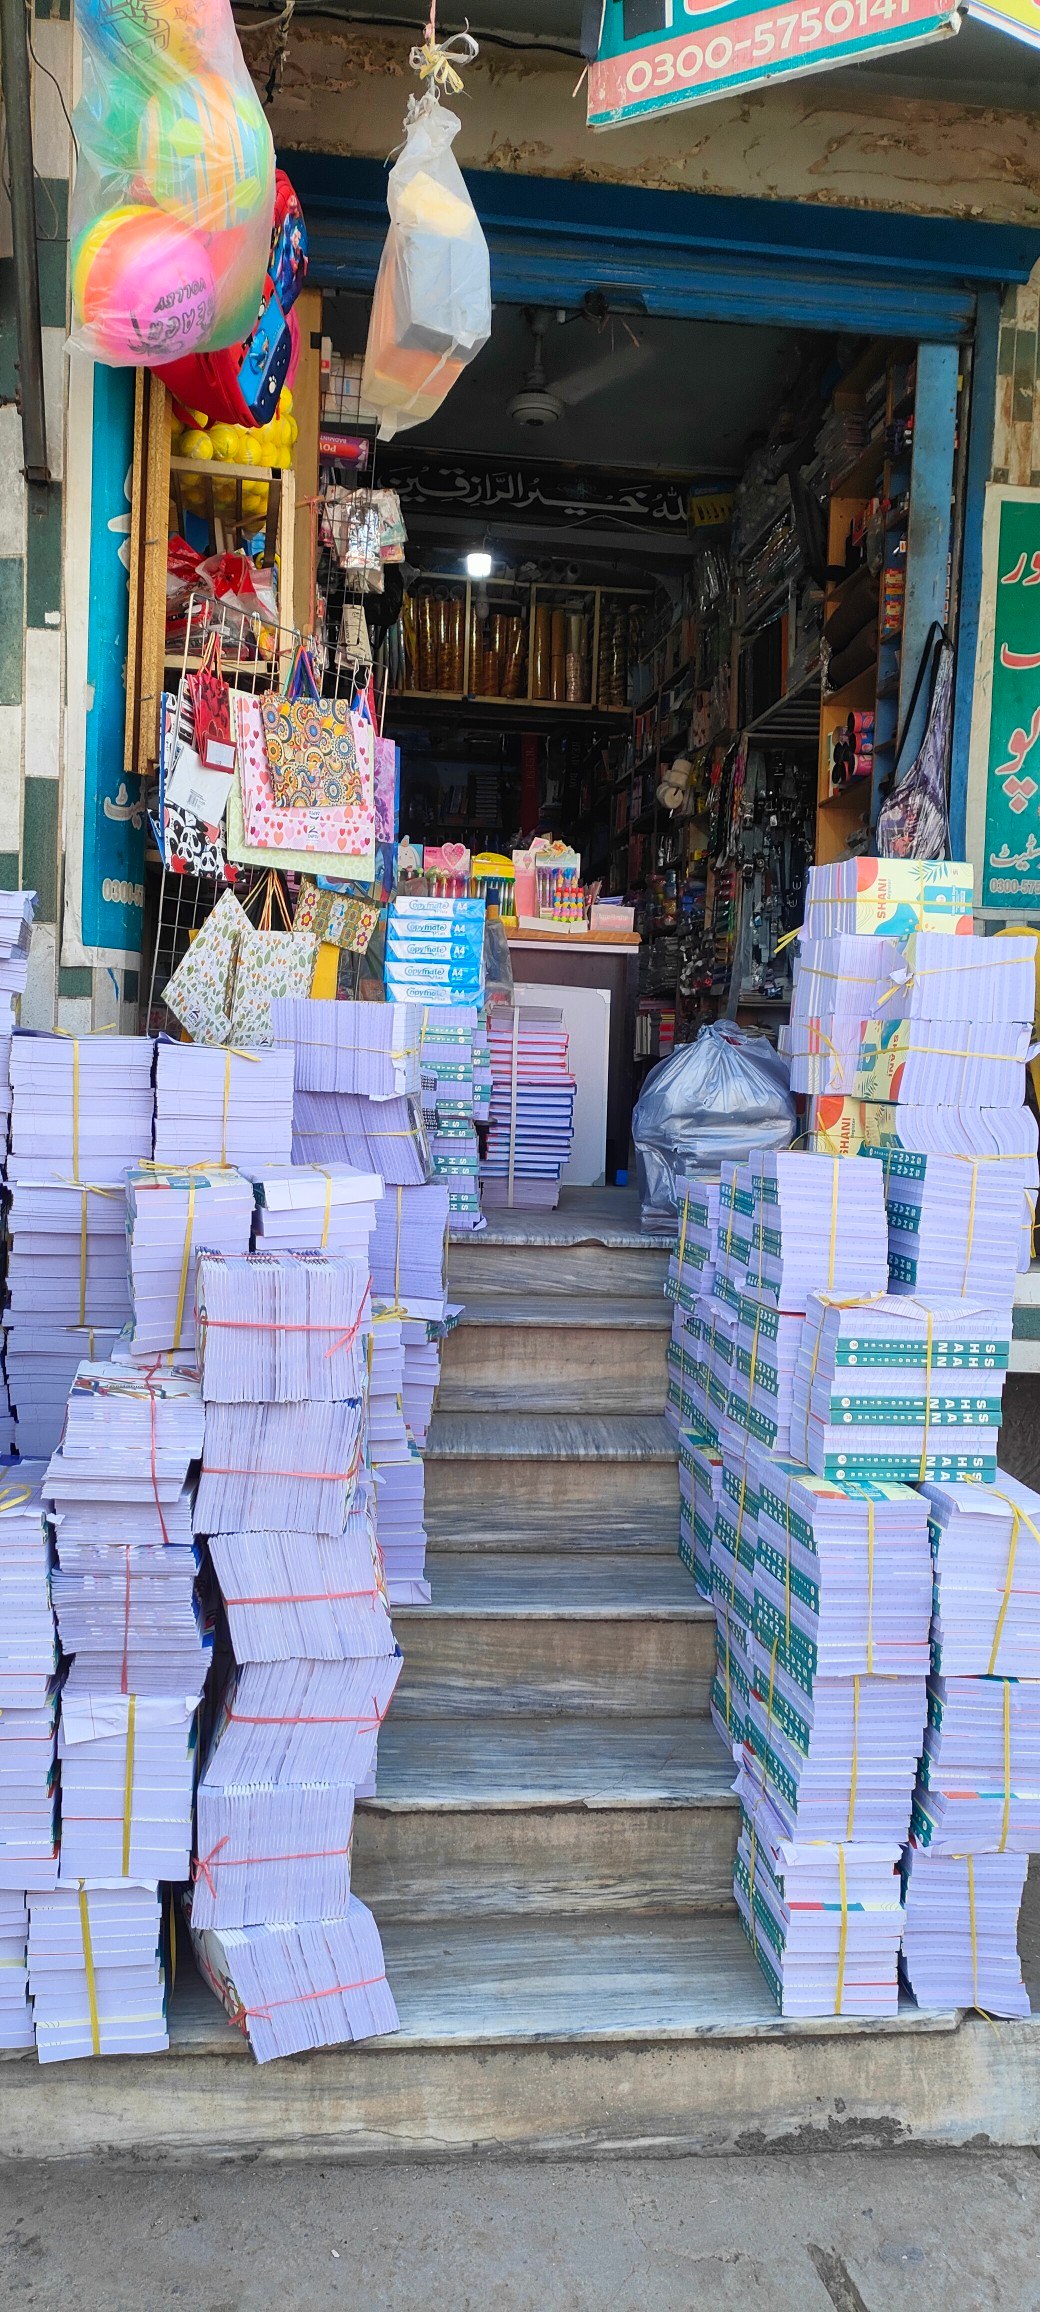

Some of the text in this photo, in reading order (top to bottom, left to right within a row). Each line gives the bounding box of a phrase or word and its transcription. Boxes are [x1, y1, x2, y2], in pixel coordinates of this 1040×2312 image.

[320, 435, 347, 444] BADMINT
[877, 878, 887, 919] SHANI
[454, 924, 466, 932] A4
[454, 946, 466, 954] A4
[452, 968, 463, 976] A4
[839, 1117, 851, 1154] SHANI
[922, 1342, 996, 1354] SHANI
[921, 1356, 995, 1367] SHANI
[913, 1398, 987, 1409] SHANI
[915, 1412, 989, 1423] SHANI
[910, 1456, 984, 1467] SHANI
